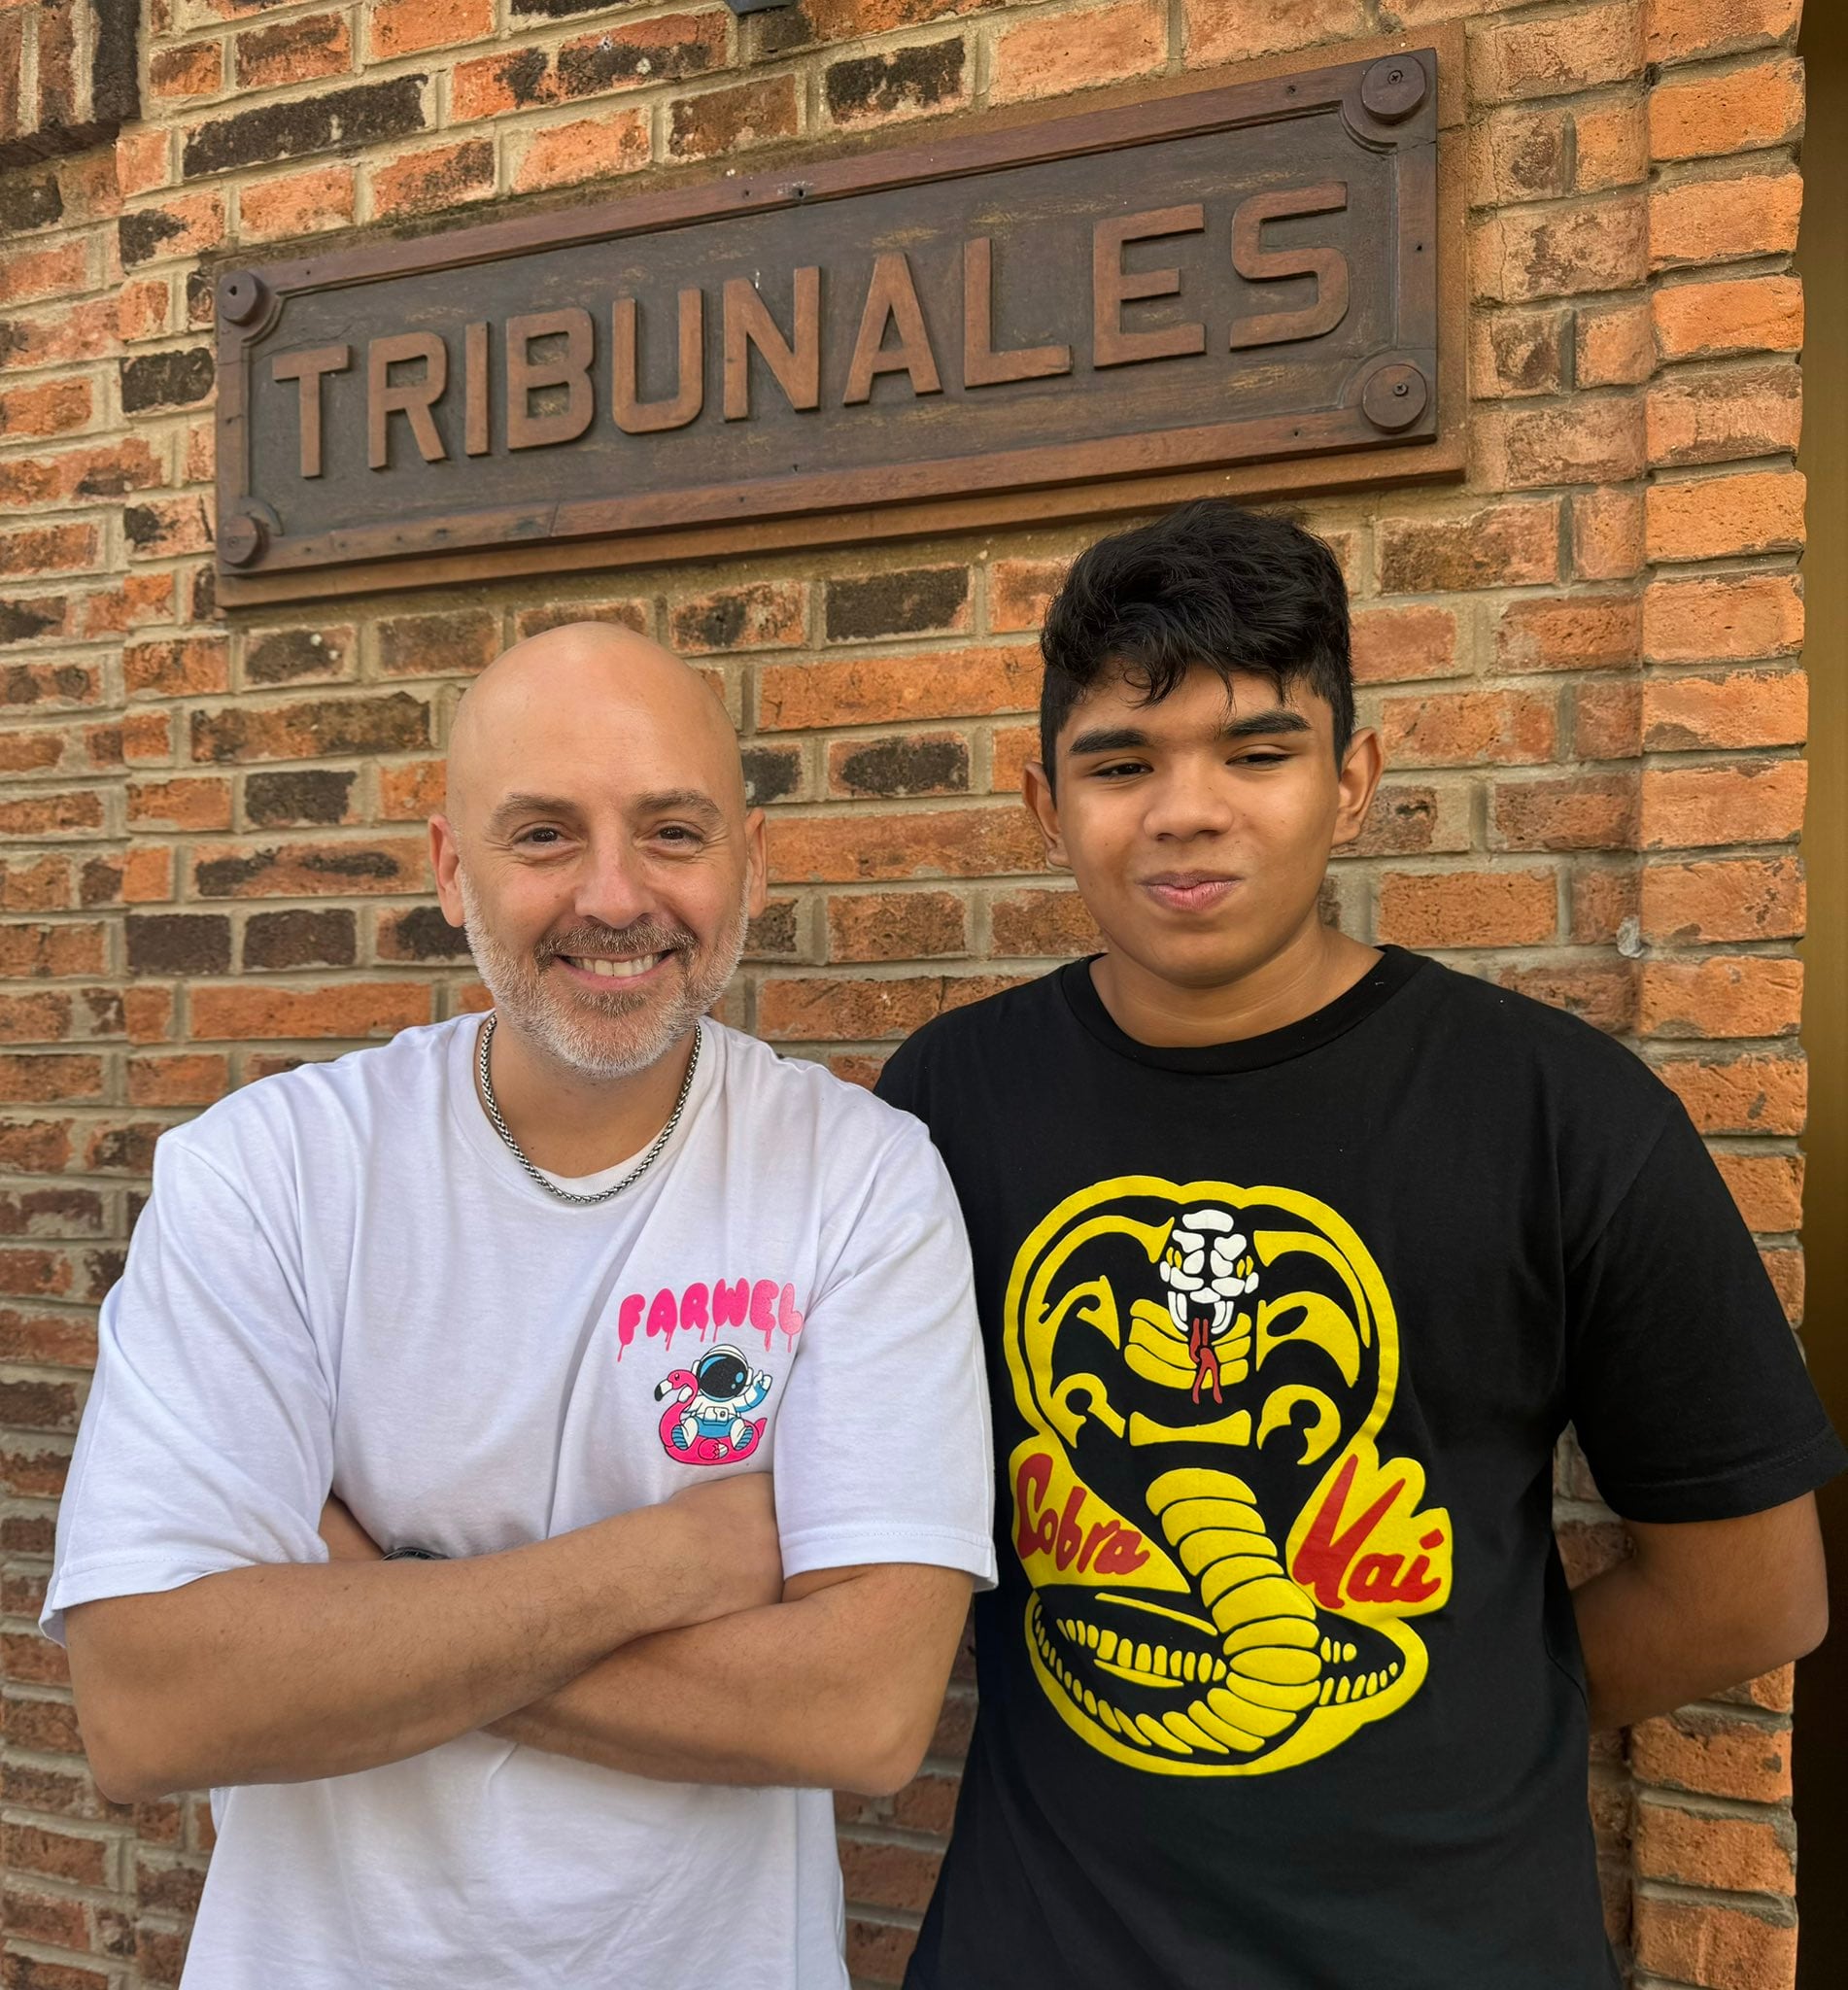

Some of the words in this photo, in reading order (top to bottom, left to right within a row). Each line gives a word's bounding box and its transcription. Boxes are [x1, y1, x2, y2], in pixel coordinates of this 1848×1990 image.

[272, 181, 1350, 478] TRIBUNALES
[617, 1278, 804, 1362] FARWEL
[1016, 1454, 1149, 1574] Cobra
[1292, 1454, 1441, 1609] Kai
